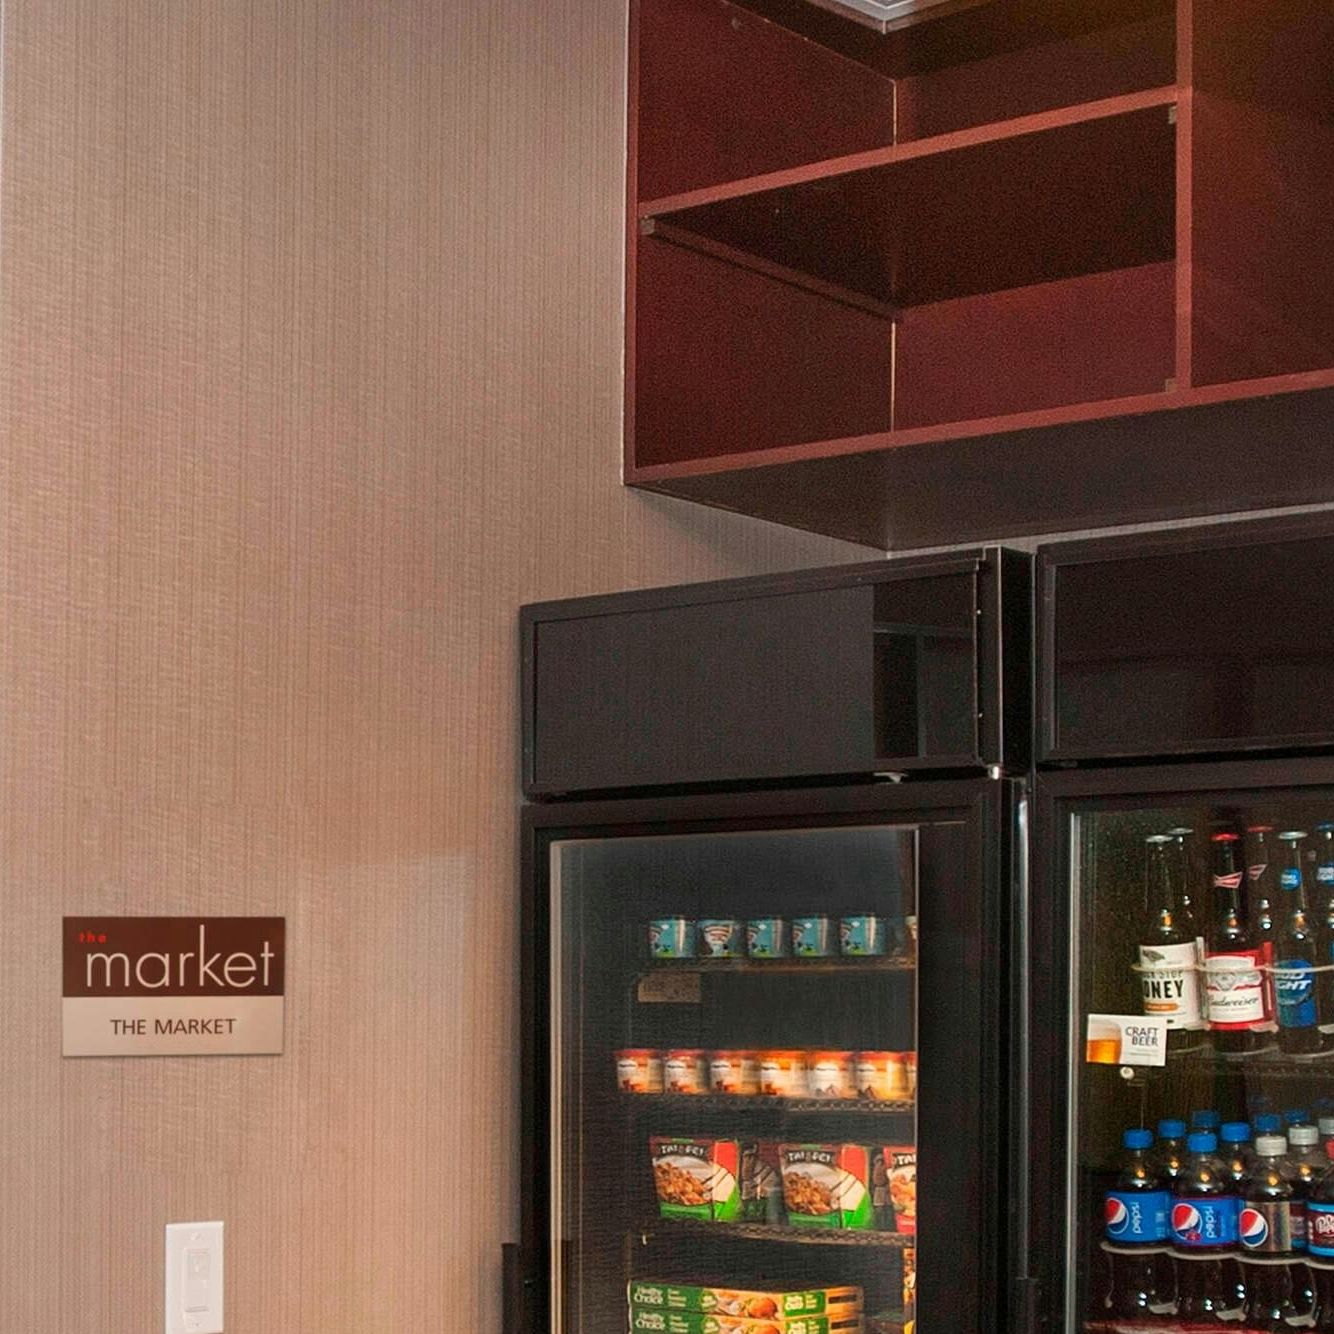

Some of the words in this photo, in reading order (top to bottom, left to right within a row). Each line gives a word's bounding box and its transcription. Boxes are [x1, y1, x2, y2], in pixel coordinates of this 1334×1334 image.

[78, 931, 107, 944] the
[86, 924, 275, 988] market
[1275, 980, 1313, 991] GHT
[110, 1019, 147, 1035] THE
[154, 1018, 237, 1035] MARKET
[1126, 1026, 1159, 1036] CRAFT
[1132, 1036, 1159, 1046] BEER
[1130, 1201, 1143, 1234] pepsi
[1204, 1206, 1216, 1239] pepsi
